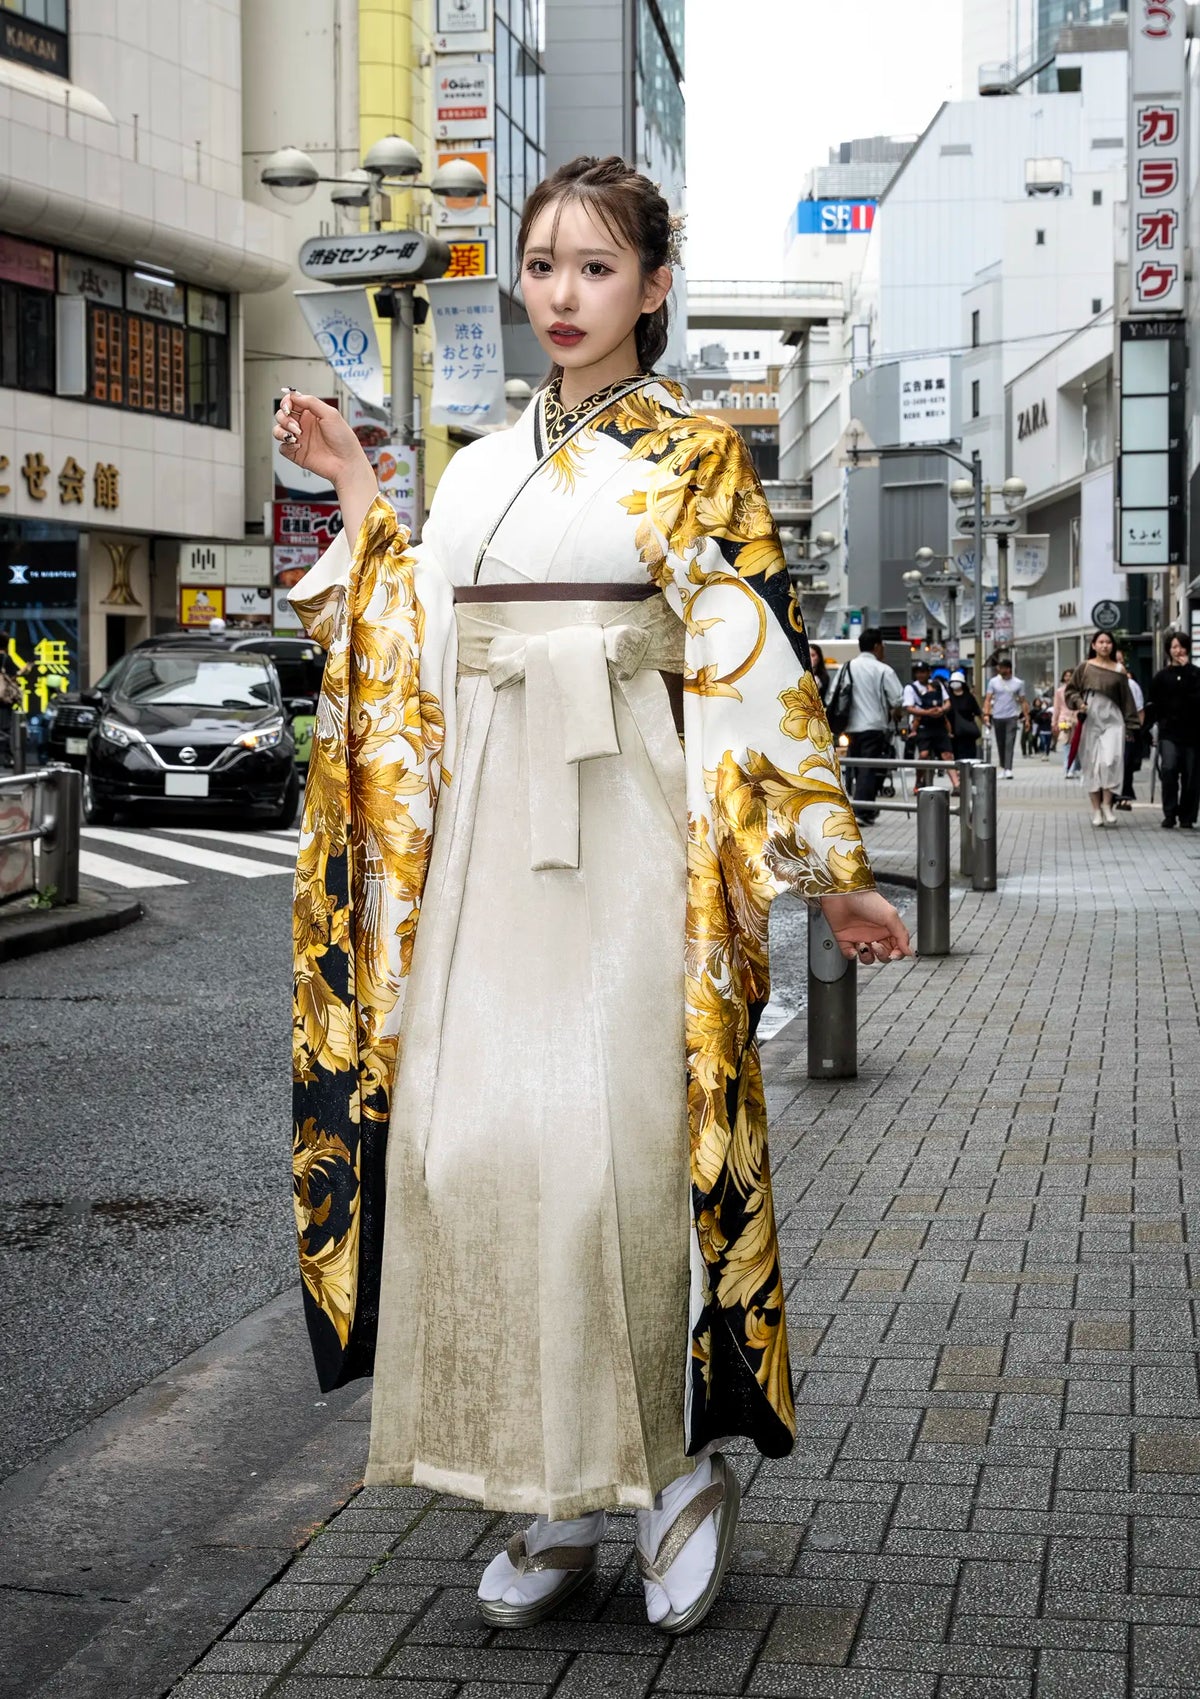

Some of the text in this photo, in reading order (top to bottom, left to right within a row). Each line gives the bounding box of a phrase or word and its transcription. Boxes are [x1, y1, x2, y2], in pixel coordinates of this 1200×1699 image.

[5, 25, 58, 61] KAIKAN
[439, 125, 448, 137] 3
[1140, 108, 1177, 300] カラオケ
[441, 212, 449, 223] 2
[306, 241, 420, 267] 渋谷センター街
[448, 245, 480, 278] 薬
[454, 322, 484, 340] 渋谷
[442, 343, 497, 360] おとなり
[441, 363, 499, 381] サンデー
[902, 378, 946, 393] 広告募集
[1016, 398, 1049, 441] ZARA
[241, 592, 255, 605] W
[1058, 602, 1077, 618] ZARA
